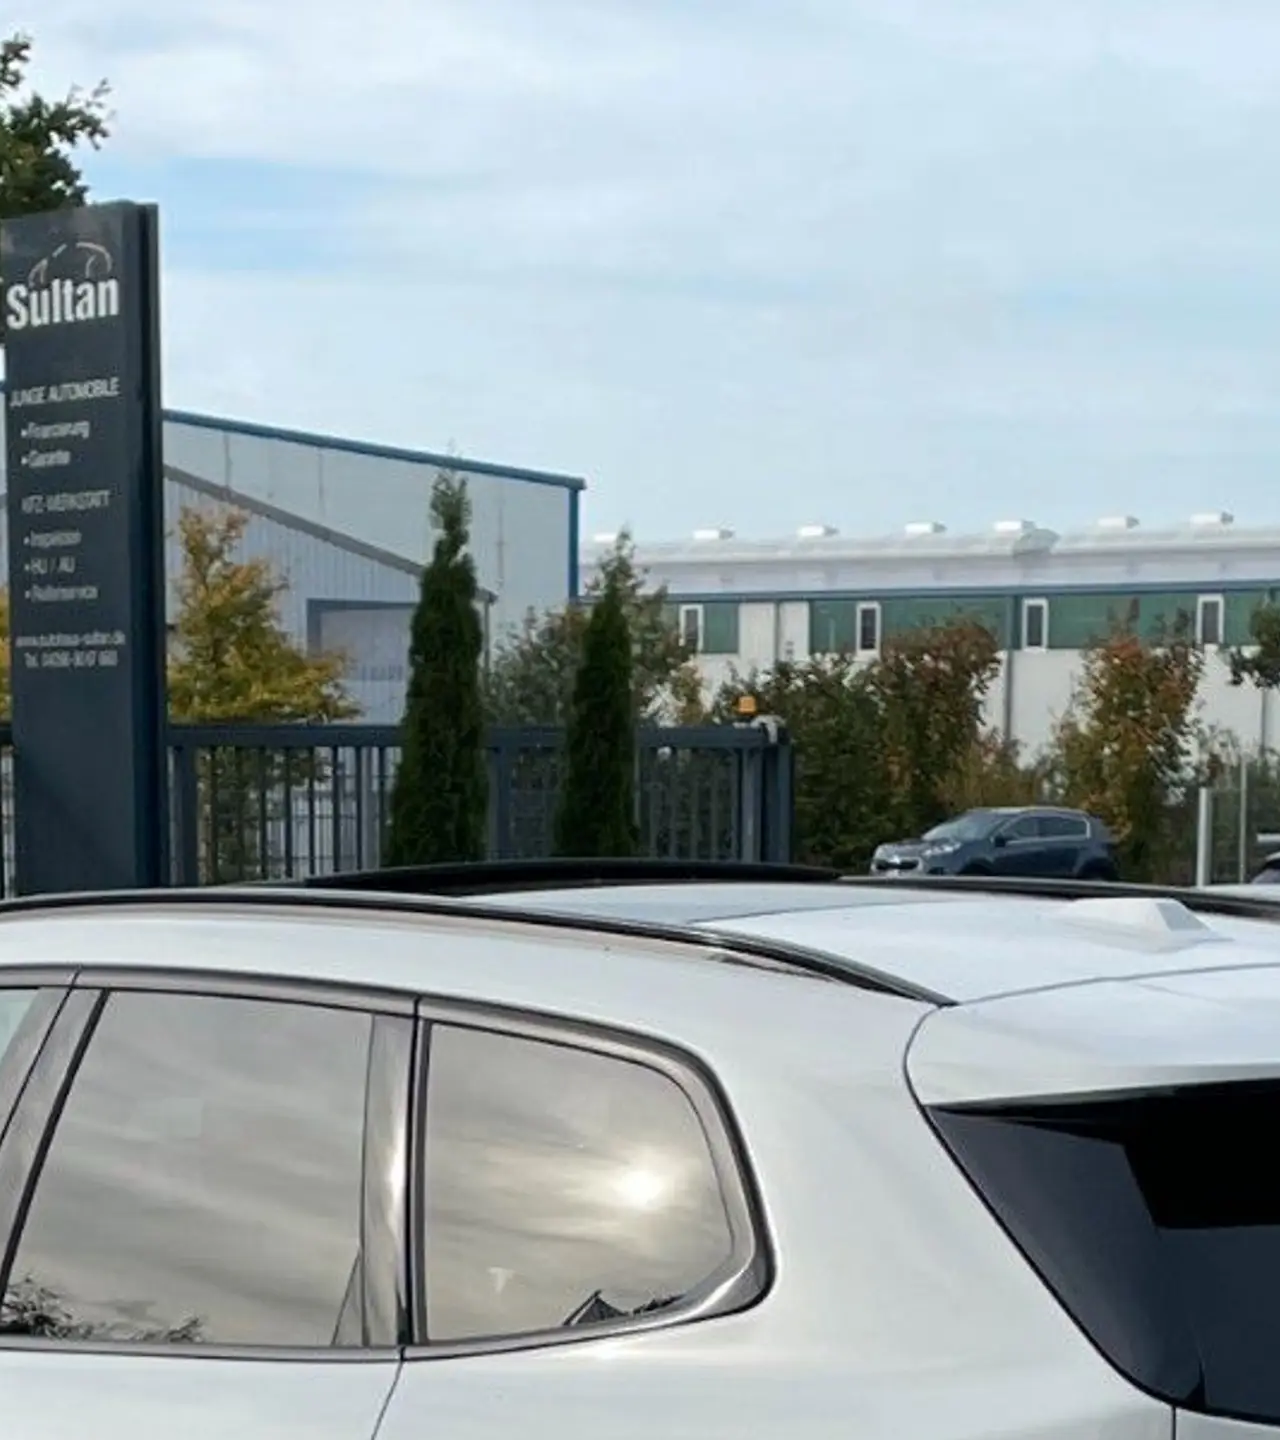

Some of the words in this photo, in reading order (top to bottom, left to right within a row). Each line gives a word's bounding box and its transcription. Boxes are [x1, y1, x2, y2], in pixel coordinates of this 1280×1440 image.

[6, 278, 119, 330] Sultan
[10, 385, 46, 406] JUNGE
[48, 377, 120, 402] AUTOMOBILE
